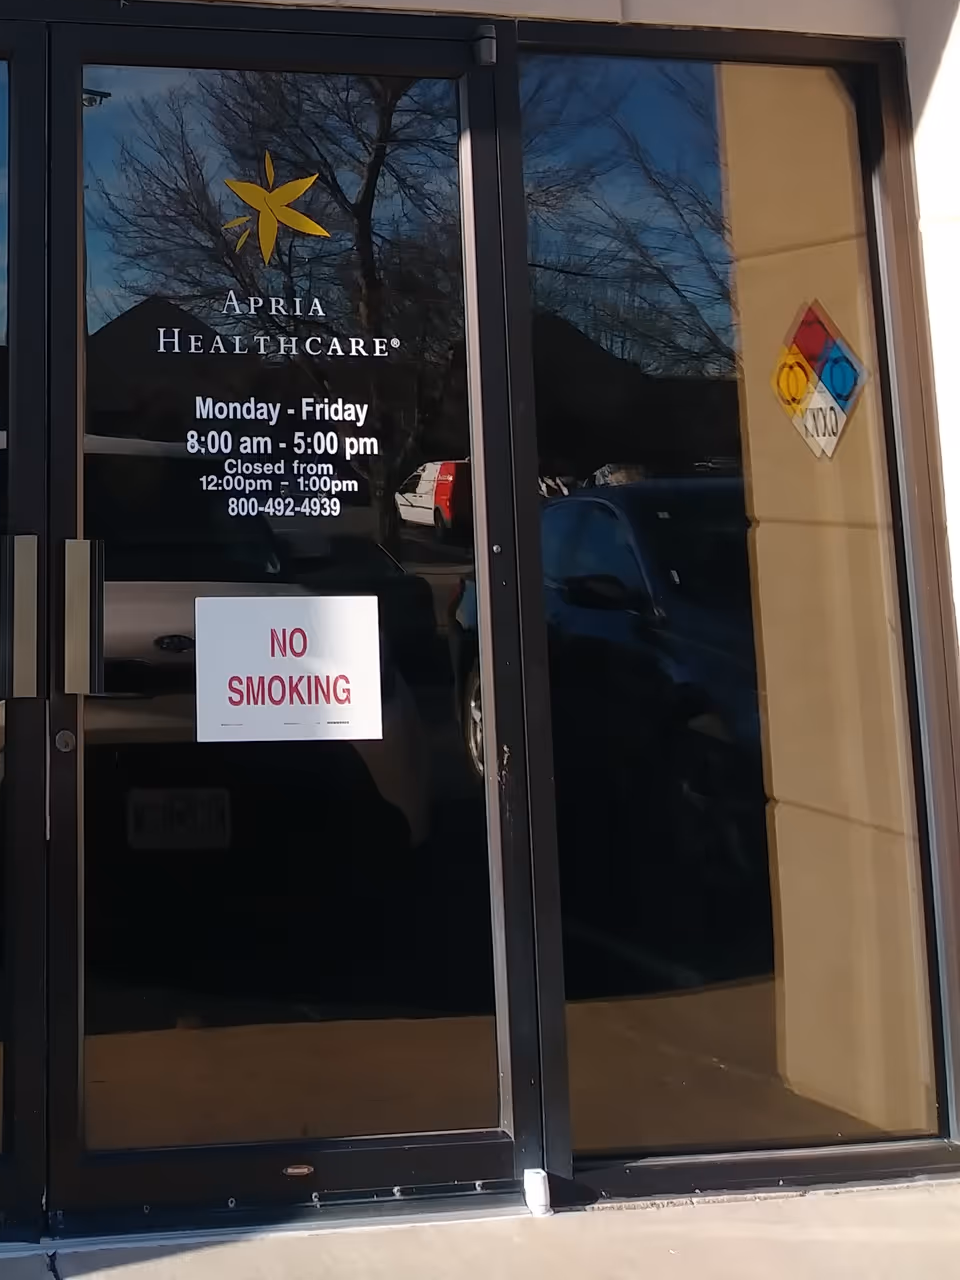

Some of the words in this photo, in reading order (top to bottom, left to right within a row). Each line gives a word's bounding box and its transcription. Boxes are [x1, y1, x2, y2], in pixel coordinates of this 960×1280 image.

[221, 290, 326, 316] APRIA
[195, 396, 281, 426] Monday
[301, 398, 369, 426] Friday
[186, 430, 232, 454] 8:00
[239, 436, 272, 454] am
[293, 431, 338, 455] 5:00
[345, 436, 379, 460] pm
[224, 459, 285, 475] Closed
[292, 459, 334, 475] from
[199, 476, 272, 493] 12:00pm
[297, 476, 358, 494] 1:00pm
[228, 497, 341, 517] 800-492-4939
[270, 628, 307, 657] NO
[228, 674, 351, 706] SMOKING
